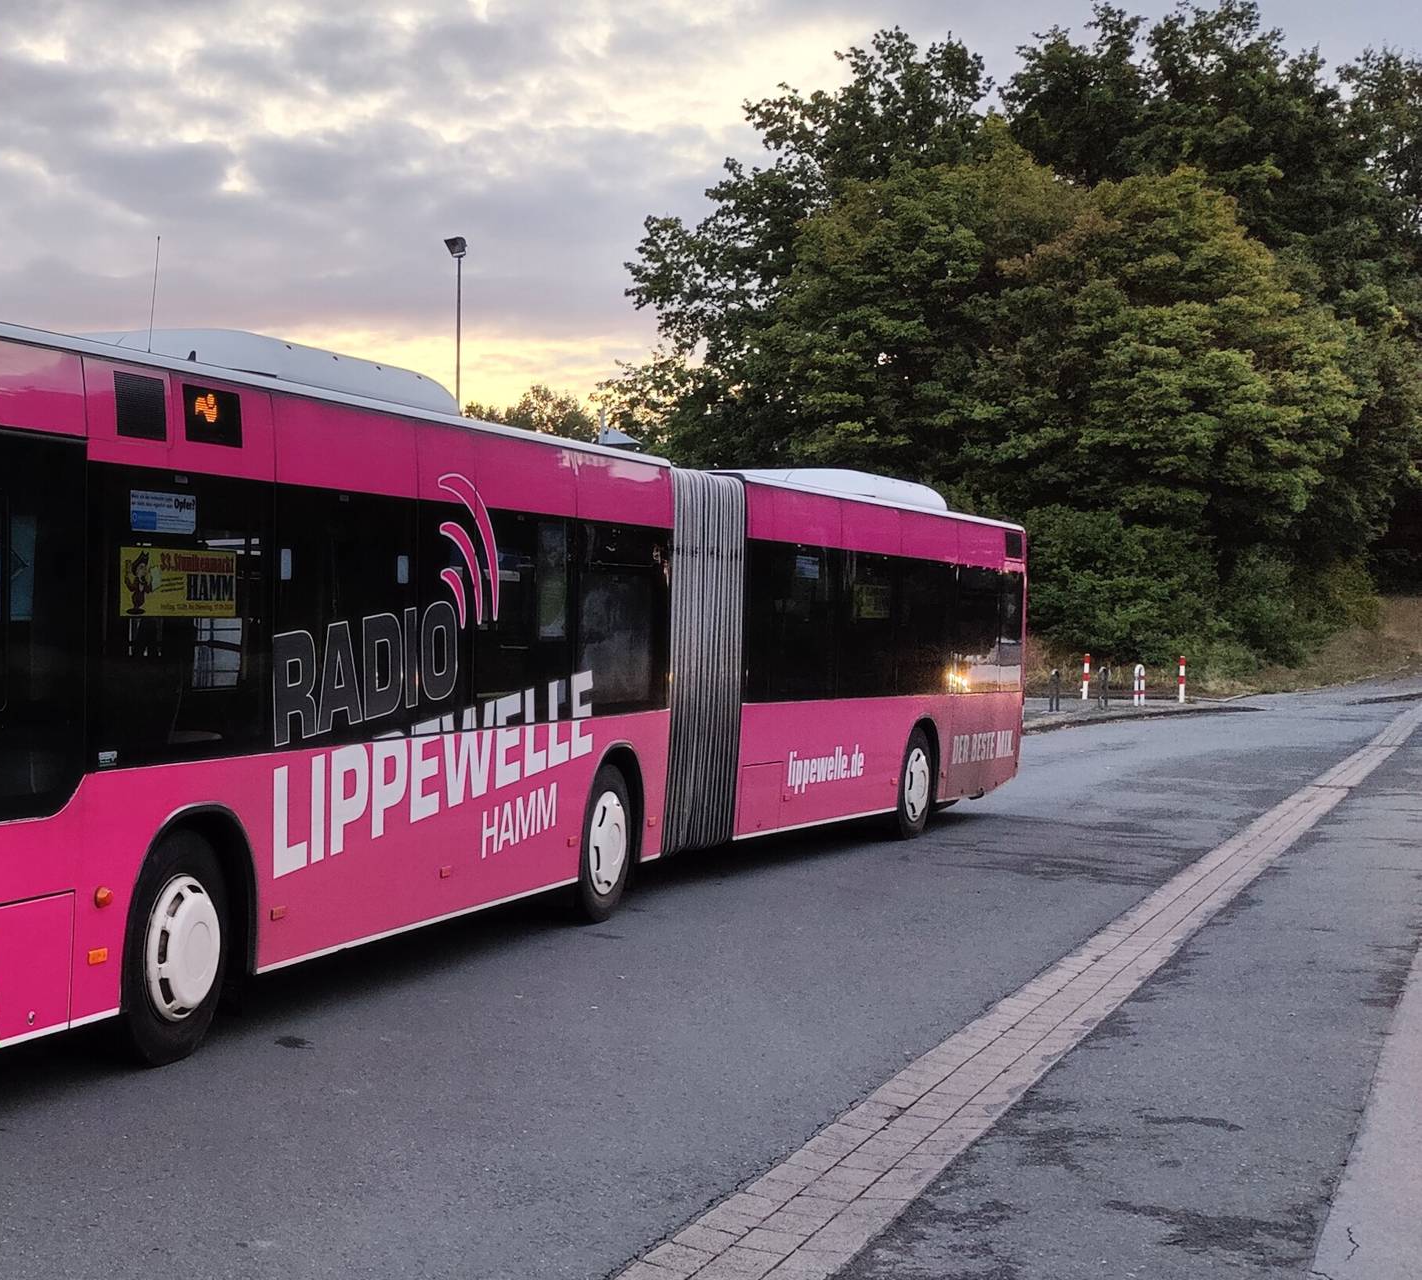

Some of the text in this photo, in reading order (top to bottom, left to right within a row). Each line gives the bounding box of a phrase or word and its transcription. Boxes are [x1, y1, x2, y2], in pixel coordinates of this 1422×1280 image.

[186, 574, 235, 602] HAMM
[273, 601, 458, 747] RADIO
[273, 670, 593, 879] LIPPEWELLE
[787, 744, 865, 795] lippewelle.de
[481, 782, 557, 860] HAMM
